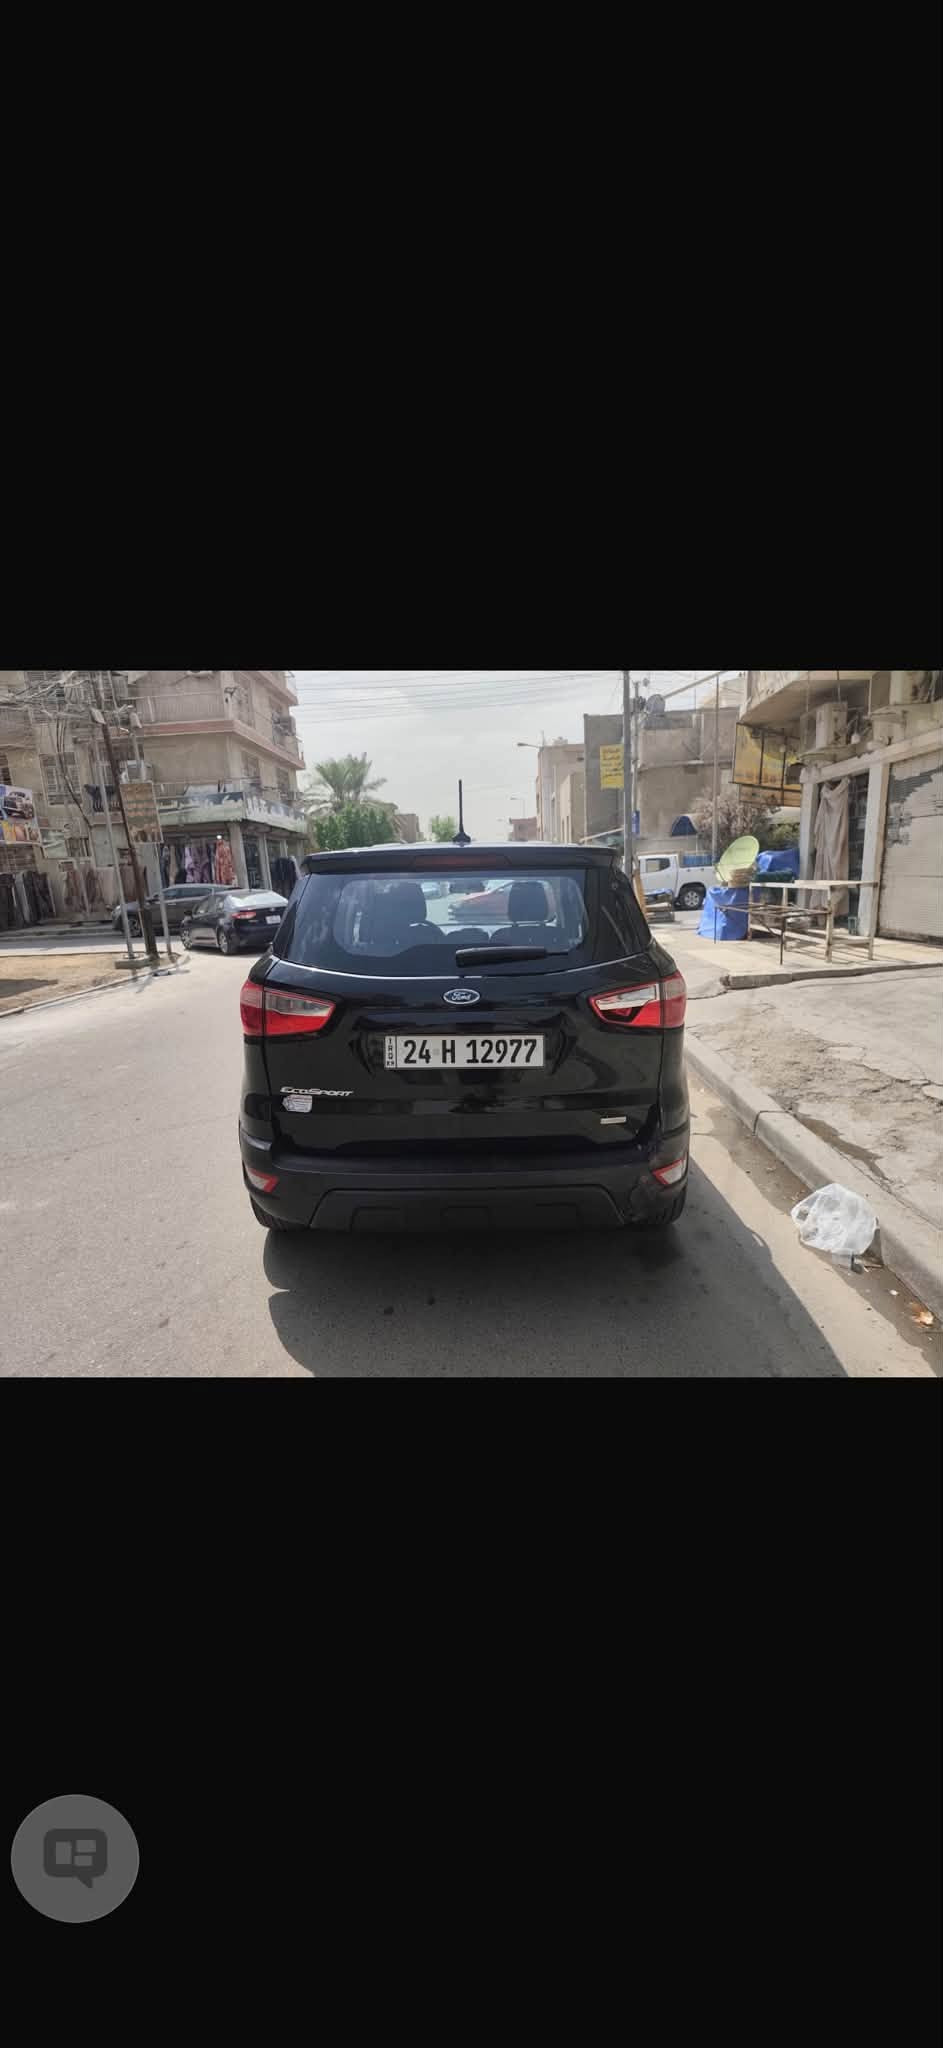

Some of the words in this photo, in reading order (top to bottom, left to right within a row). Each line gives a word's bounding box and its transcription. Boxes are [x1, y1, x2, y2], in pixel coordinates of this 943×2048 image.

[451, 991, 472, 1001] Ford
[403, 1039, 432, 1064] 24
[441, 1039, 456, 1064] H
[465, 1039, 537, 1064] 12977
